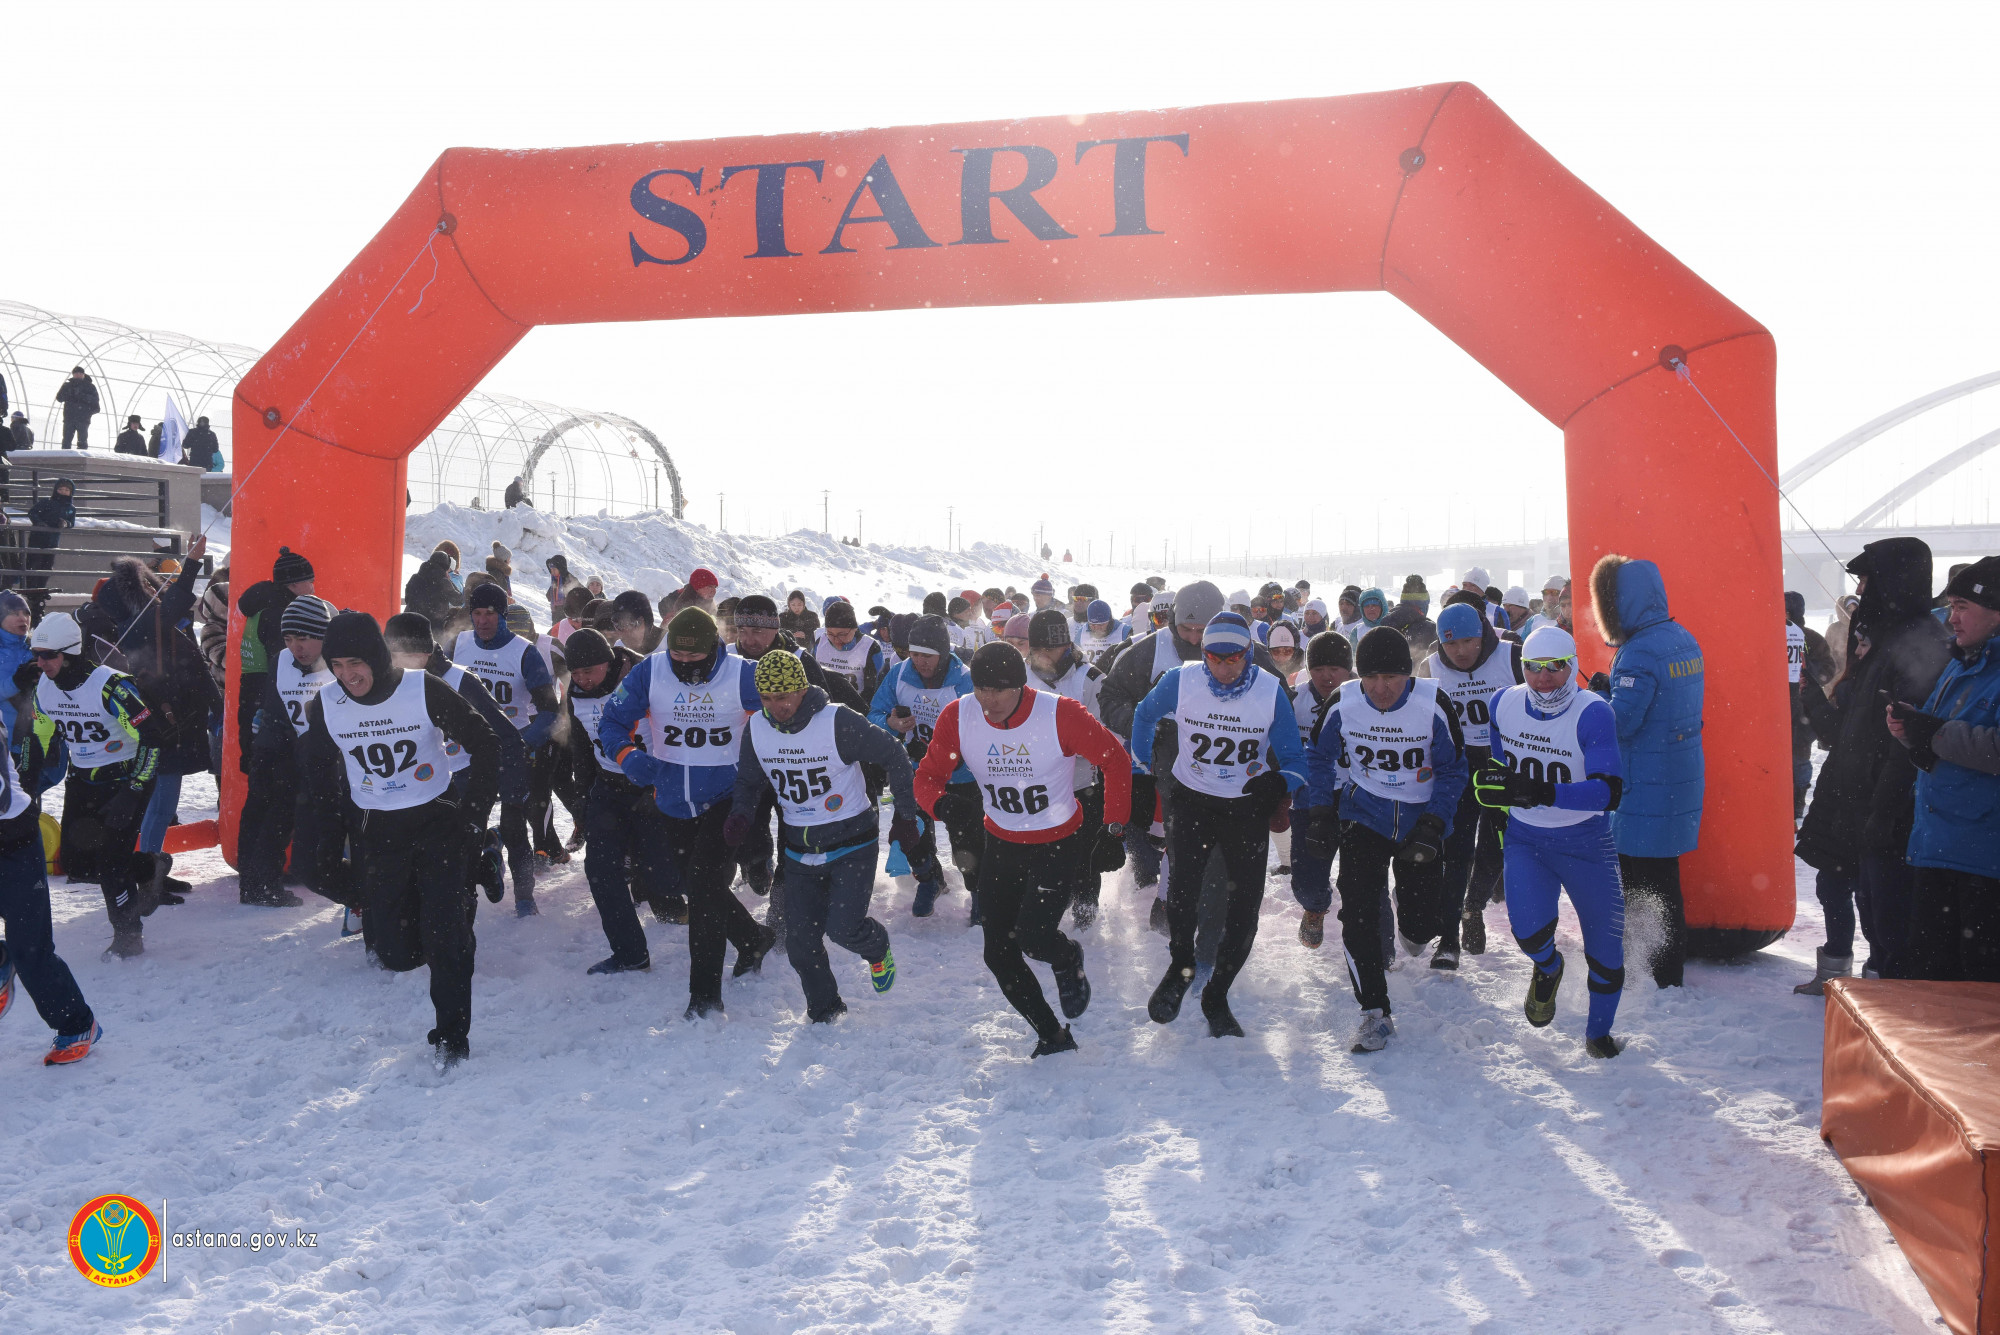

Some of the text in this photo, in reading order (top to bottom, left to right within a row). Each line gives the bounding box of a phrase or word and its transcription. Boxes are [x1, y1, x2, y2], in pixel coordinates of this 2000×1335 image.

[629, 133, 1190, 268] START
[480, 667, 515, 677] TRIATHLON
[1458, 680, 1486, 688] ASTANA
[358, 718, 393, 728] ASTANA
[1184, 717, 1265, 734] WINTER TRIATHLON
[1207, 713, 1241, 723] ASTANA
[338, 724, 421, 739] WINTER TRIATHLON
[664, 725, 732, 748] 205
[1349, 731, 1428, 743] WINTER TRIATHLON
[1519, 732, 1551, 743] ASTANA
[1190, 733, 1259, 766] 228
[1527, 743, 1573, 758] TRIATHLON
[348, 739, 418, 778] 192
[787, 755, 829, 764] TRIATHLON
[1355, 745, 1425, 772] 230
[770, 766, 832, 804] 255
[984, 783, 1049, 815] 186
